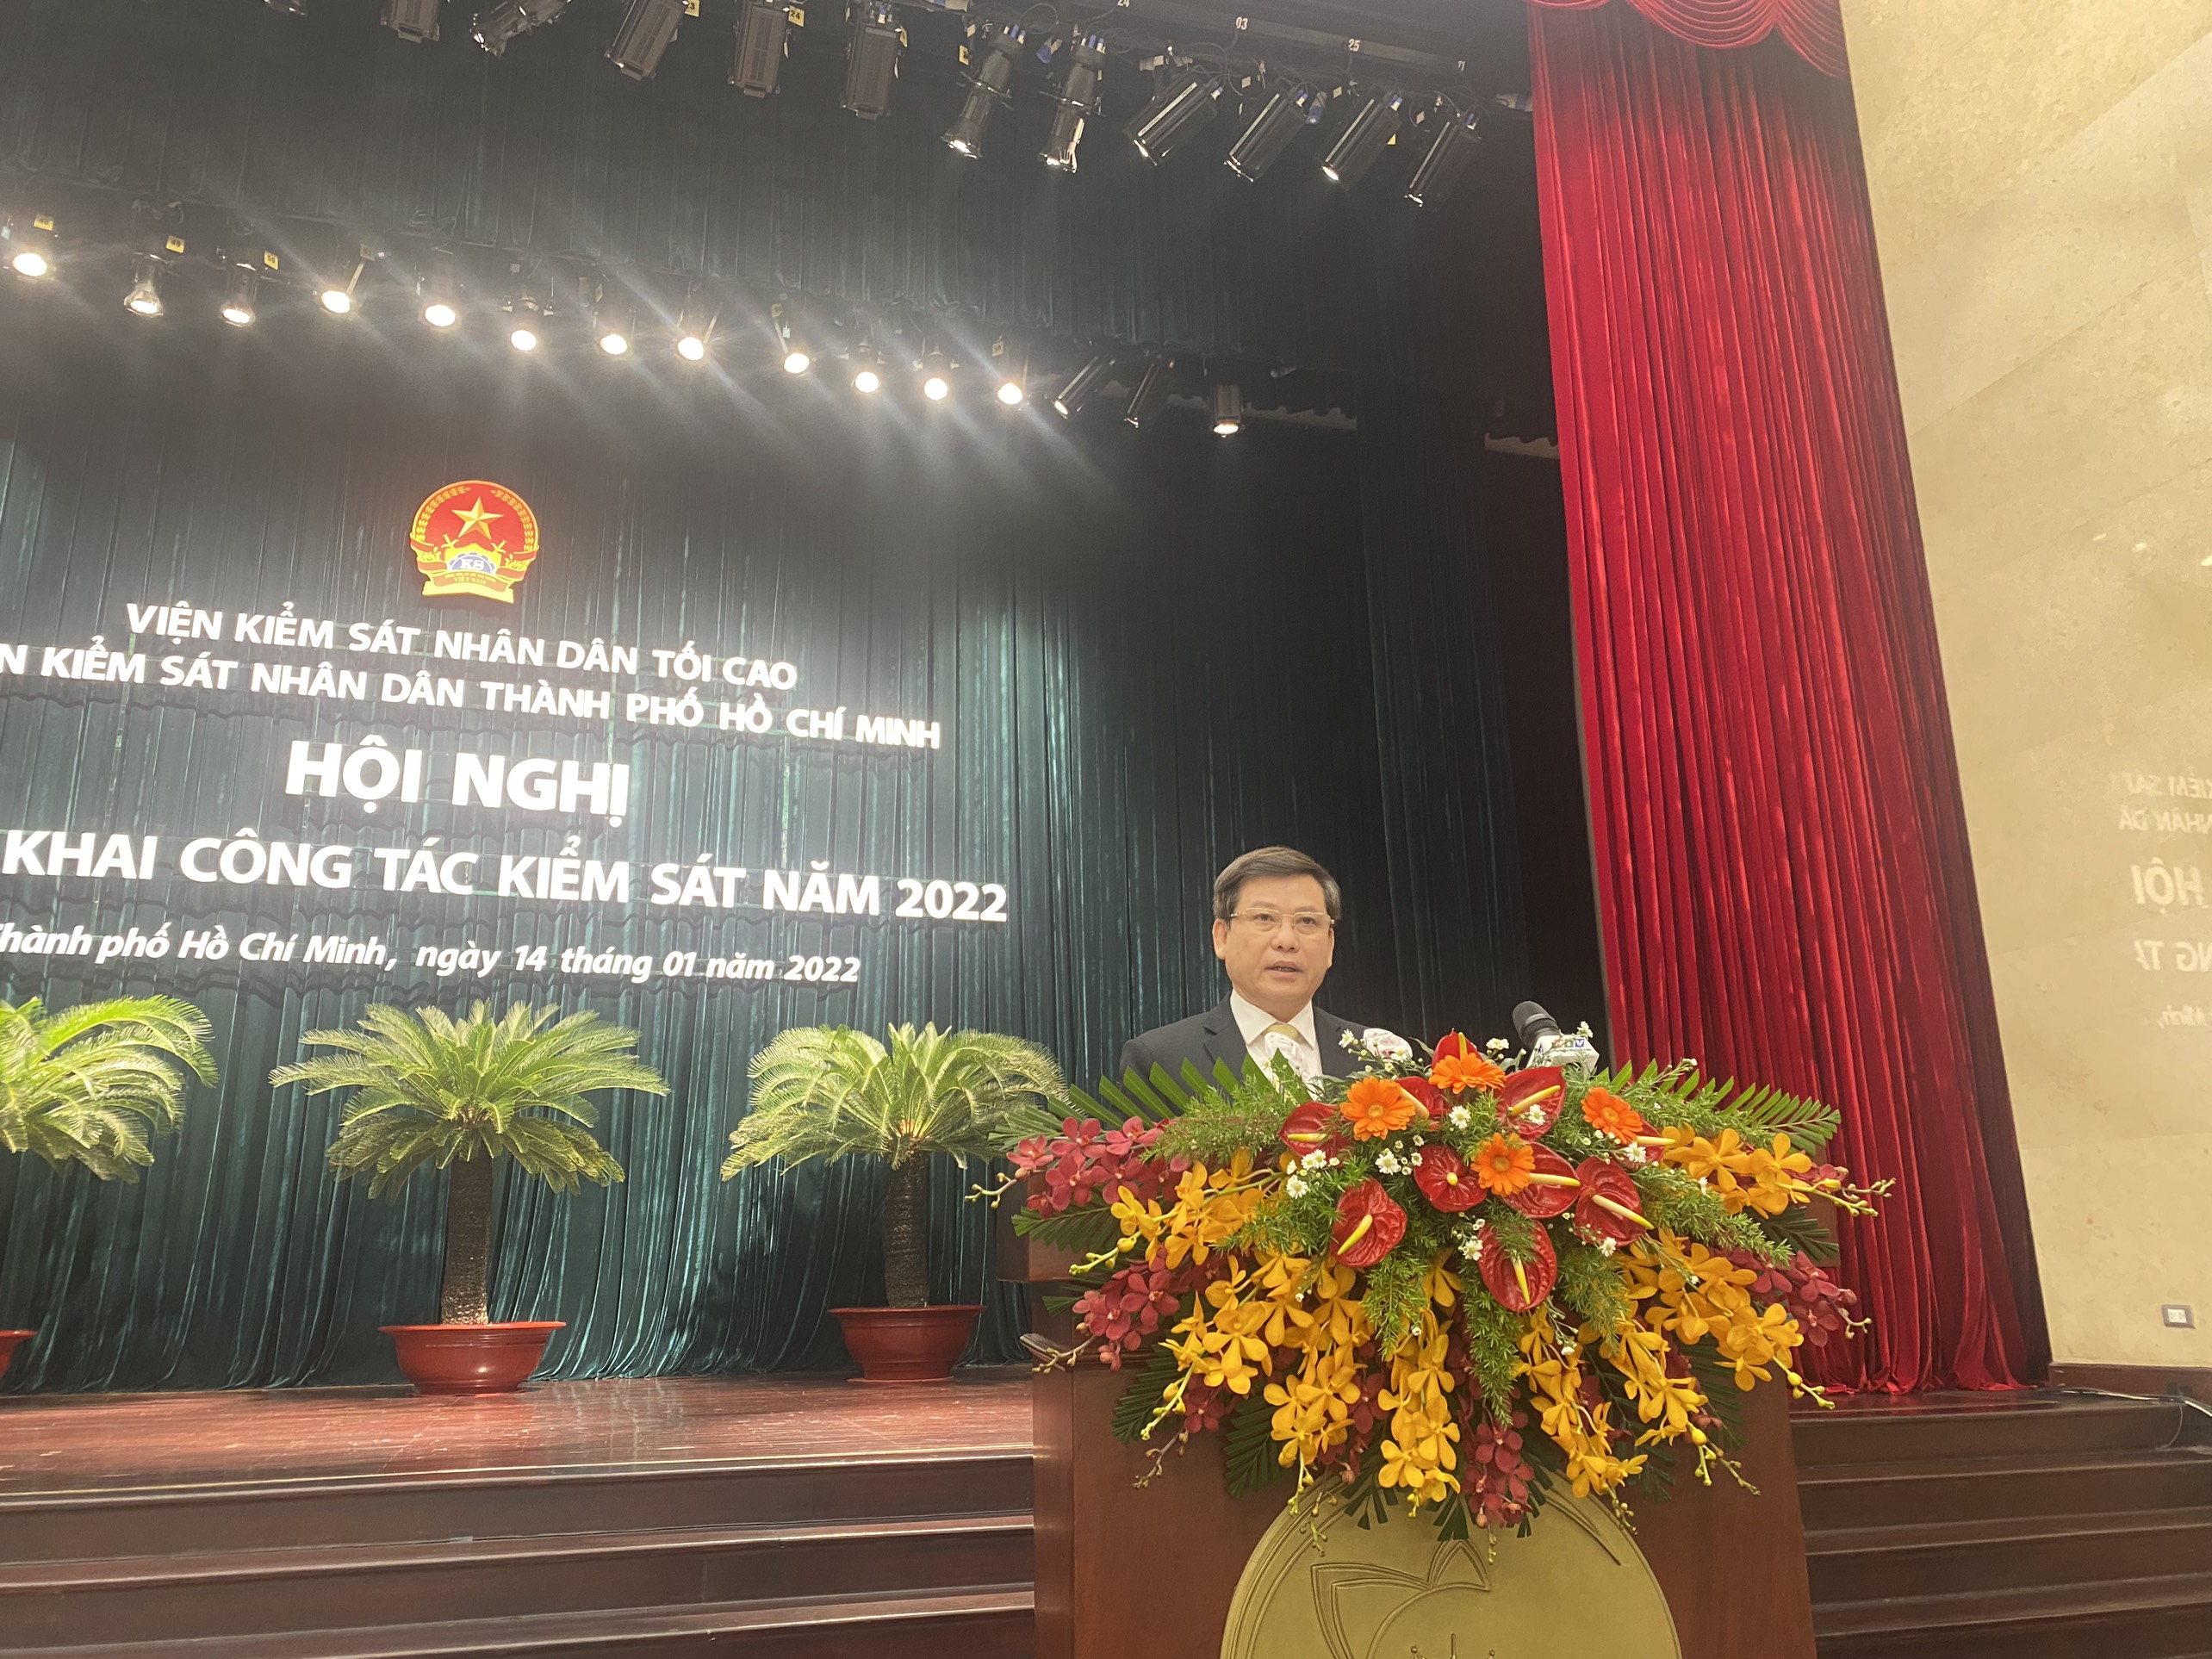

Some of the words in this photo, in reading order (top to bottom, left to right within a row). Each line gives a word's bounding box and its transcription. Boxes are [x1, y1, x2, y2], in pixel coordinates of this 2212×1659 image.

[790, 9, 801, 20] 24
[1235, 16, 1248, 30] 03
[1348, 38, 1361, 52] 25
[127, 600, 223, 645] VIỆN
[234, 601, 334, 650] KIỂM
[348, 619, 421, 656] SÁT
[434, 628, 545, 667] NHÂN
[556, 637, 638, 675] DÂN
[652, 640, 711, 682] TỐI
[722, 656, 798, 690] CAO
[40, 635, 146, 684] KIỂM
[159, 651, 239, 690] SÁT
[251, 661, 368, 700] NHÂN
[381, 669, 465, 708] DÂN
[480, 679, 611, 719] THÀNH
[626, 686, 705, 728] PHỐ
[719, 693, 774, 734] HỒ
[786, 706, 847, 741] CHÍ
[854, 714, 940, 749] MINH
[285, 734, 423, 814] HỘI
[451, 752, 630, 828] NGHỊ
[2, 830, 158, 880] KHAI
[180, 827, 352, 889] CÔNG
[373, 837, 480, 895] TÁC
[497, 835, 630, 904] KIỂM
[650, 853, 747, 908] SÁT
[762, 860, 879, 916] NĂM
[895, 878, 1007, 922] 2022
[0, 922, 93, 955] hành
[95, 922, 172, 964] phố
[177, 924, 229, 960] Hồ
[239, 932, 297, 962] Chí
[302, 935, 397, 972] Minh,
[415, 940, 502, 978] ngày
[515, 945, 548, 972] 14
[561, 946, 653, 984] tháng
[662, 950, 697, 977] 01
[705, 952, 775, 980] năm
[783, 954, 861, 982] 2022
